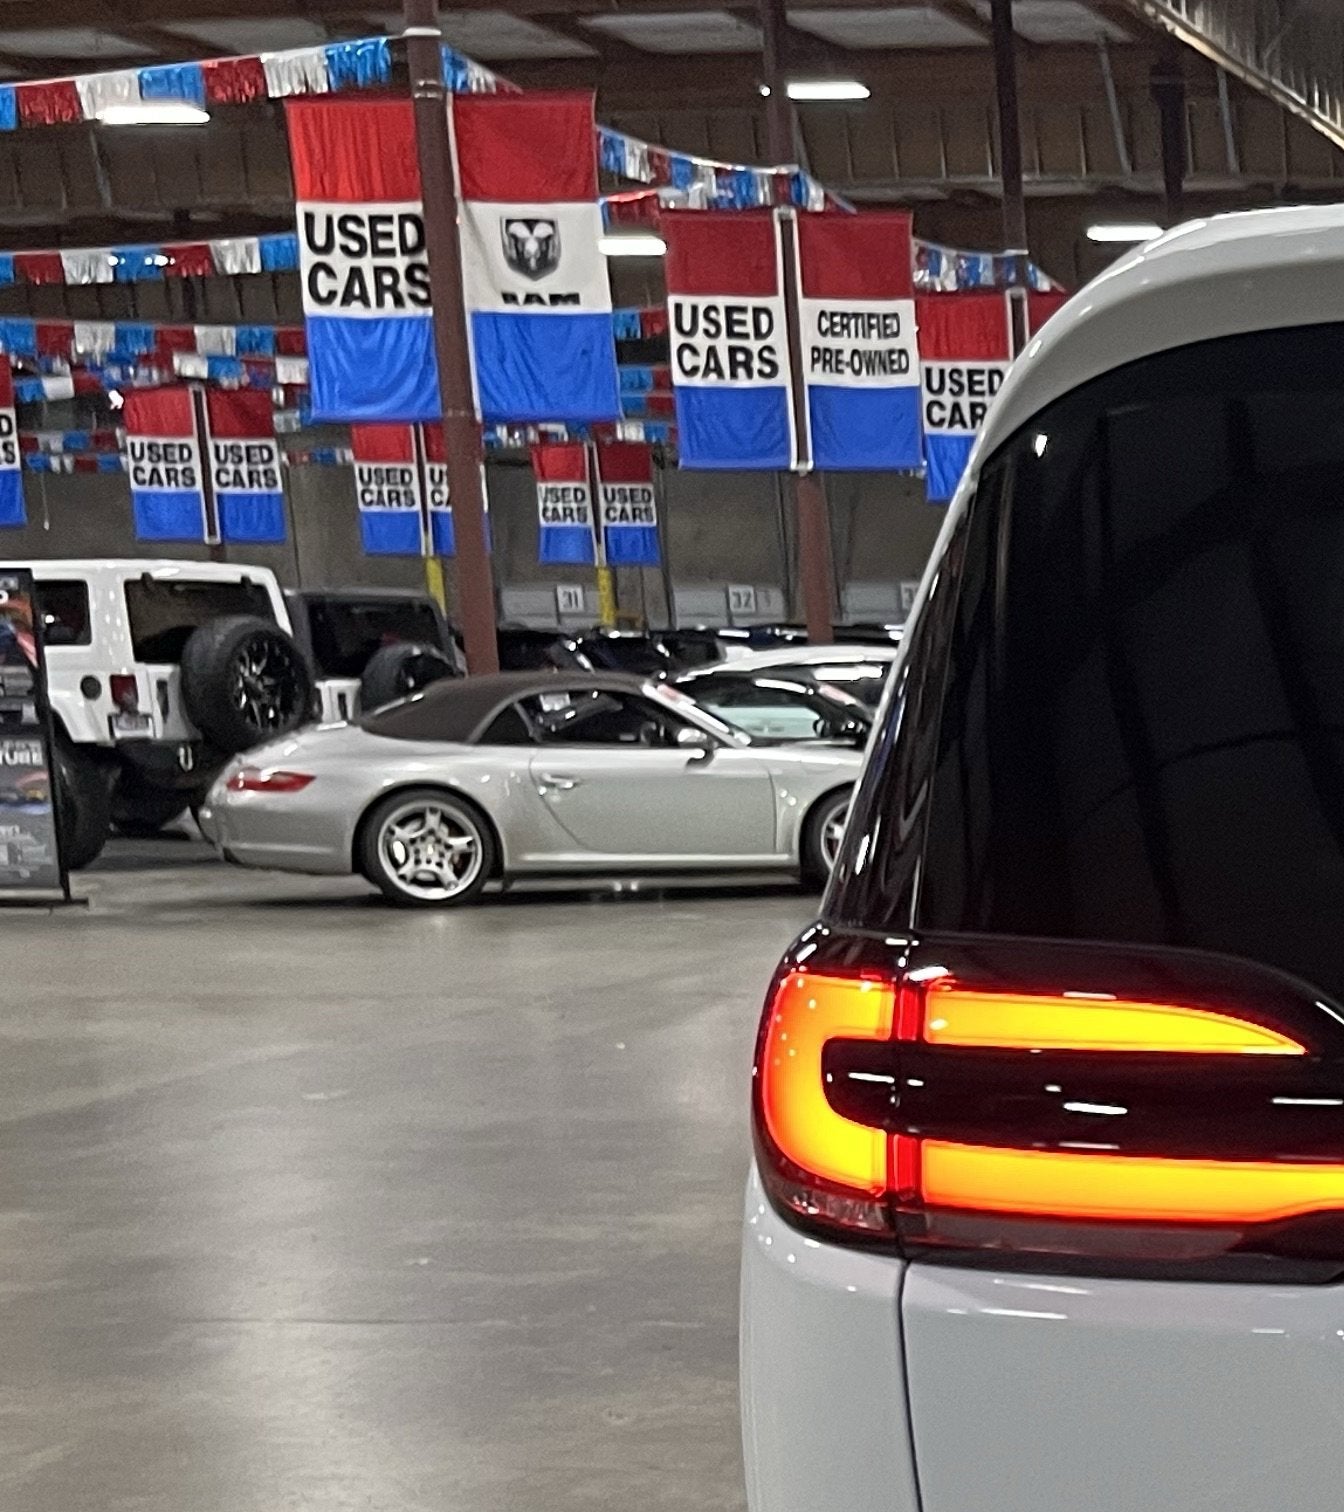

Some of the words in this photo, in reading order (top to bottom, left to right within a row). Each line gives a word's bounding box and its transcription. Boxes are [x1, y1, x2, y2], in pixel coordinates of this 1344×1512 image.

[304, 211, 426, 258] USED
[307, 261, 431, 309] CARS
[673, 303, 775, 341] USED
[817, 310, 901, 339] CERTIFIED
[676, 343, 780, 381] CARS
[811, 346, 910, 377] PRE-OWNED
[925, 367, 1004, 397] USED
[926, 400, 989, 430] CAR
[130, 441, 193, 465] USED
[214, 443, 275, 466] USED
[132, 466, 196, 488] CARS
[215, 468, 278, 489] CARS
[359, 467, 413, 487] USED
[361, 488, 416, 508] CARS
[604, 487, 652, 505] USED
[605, 506, 654, 523] CARS
